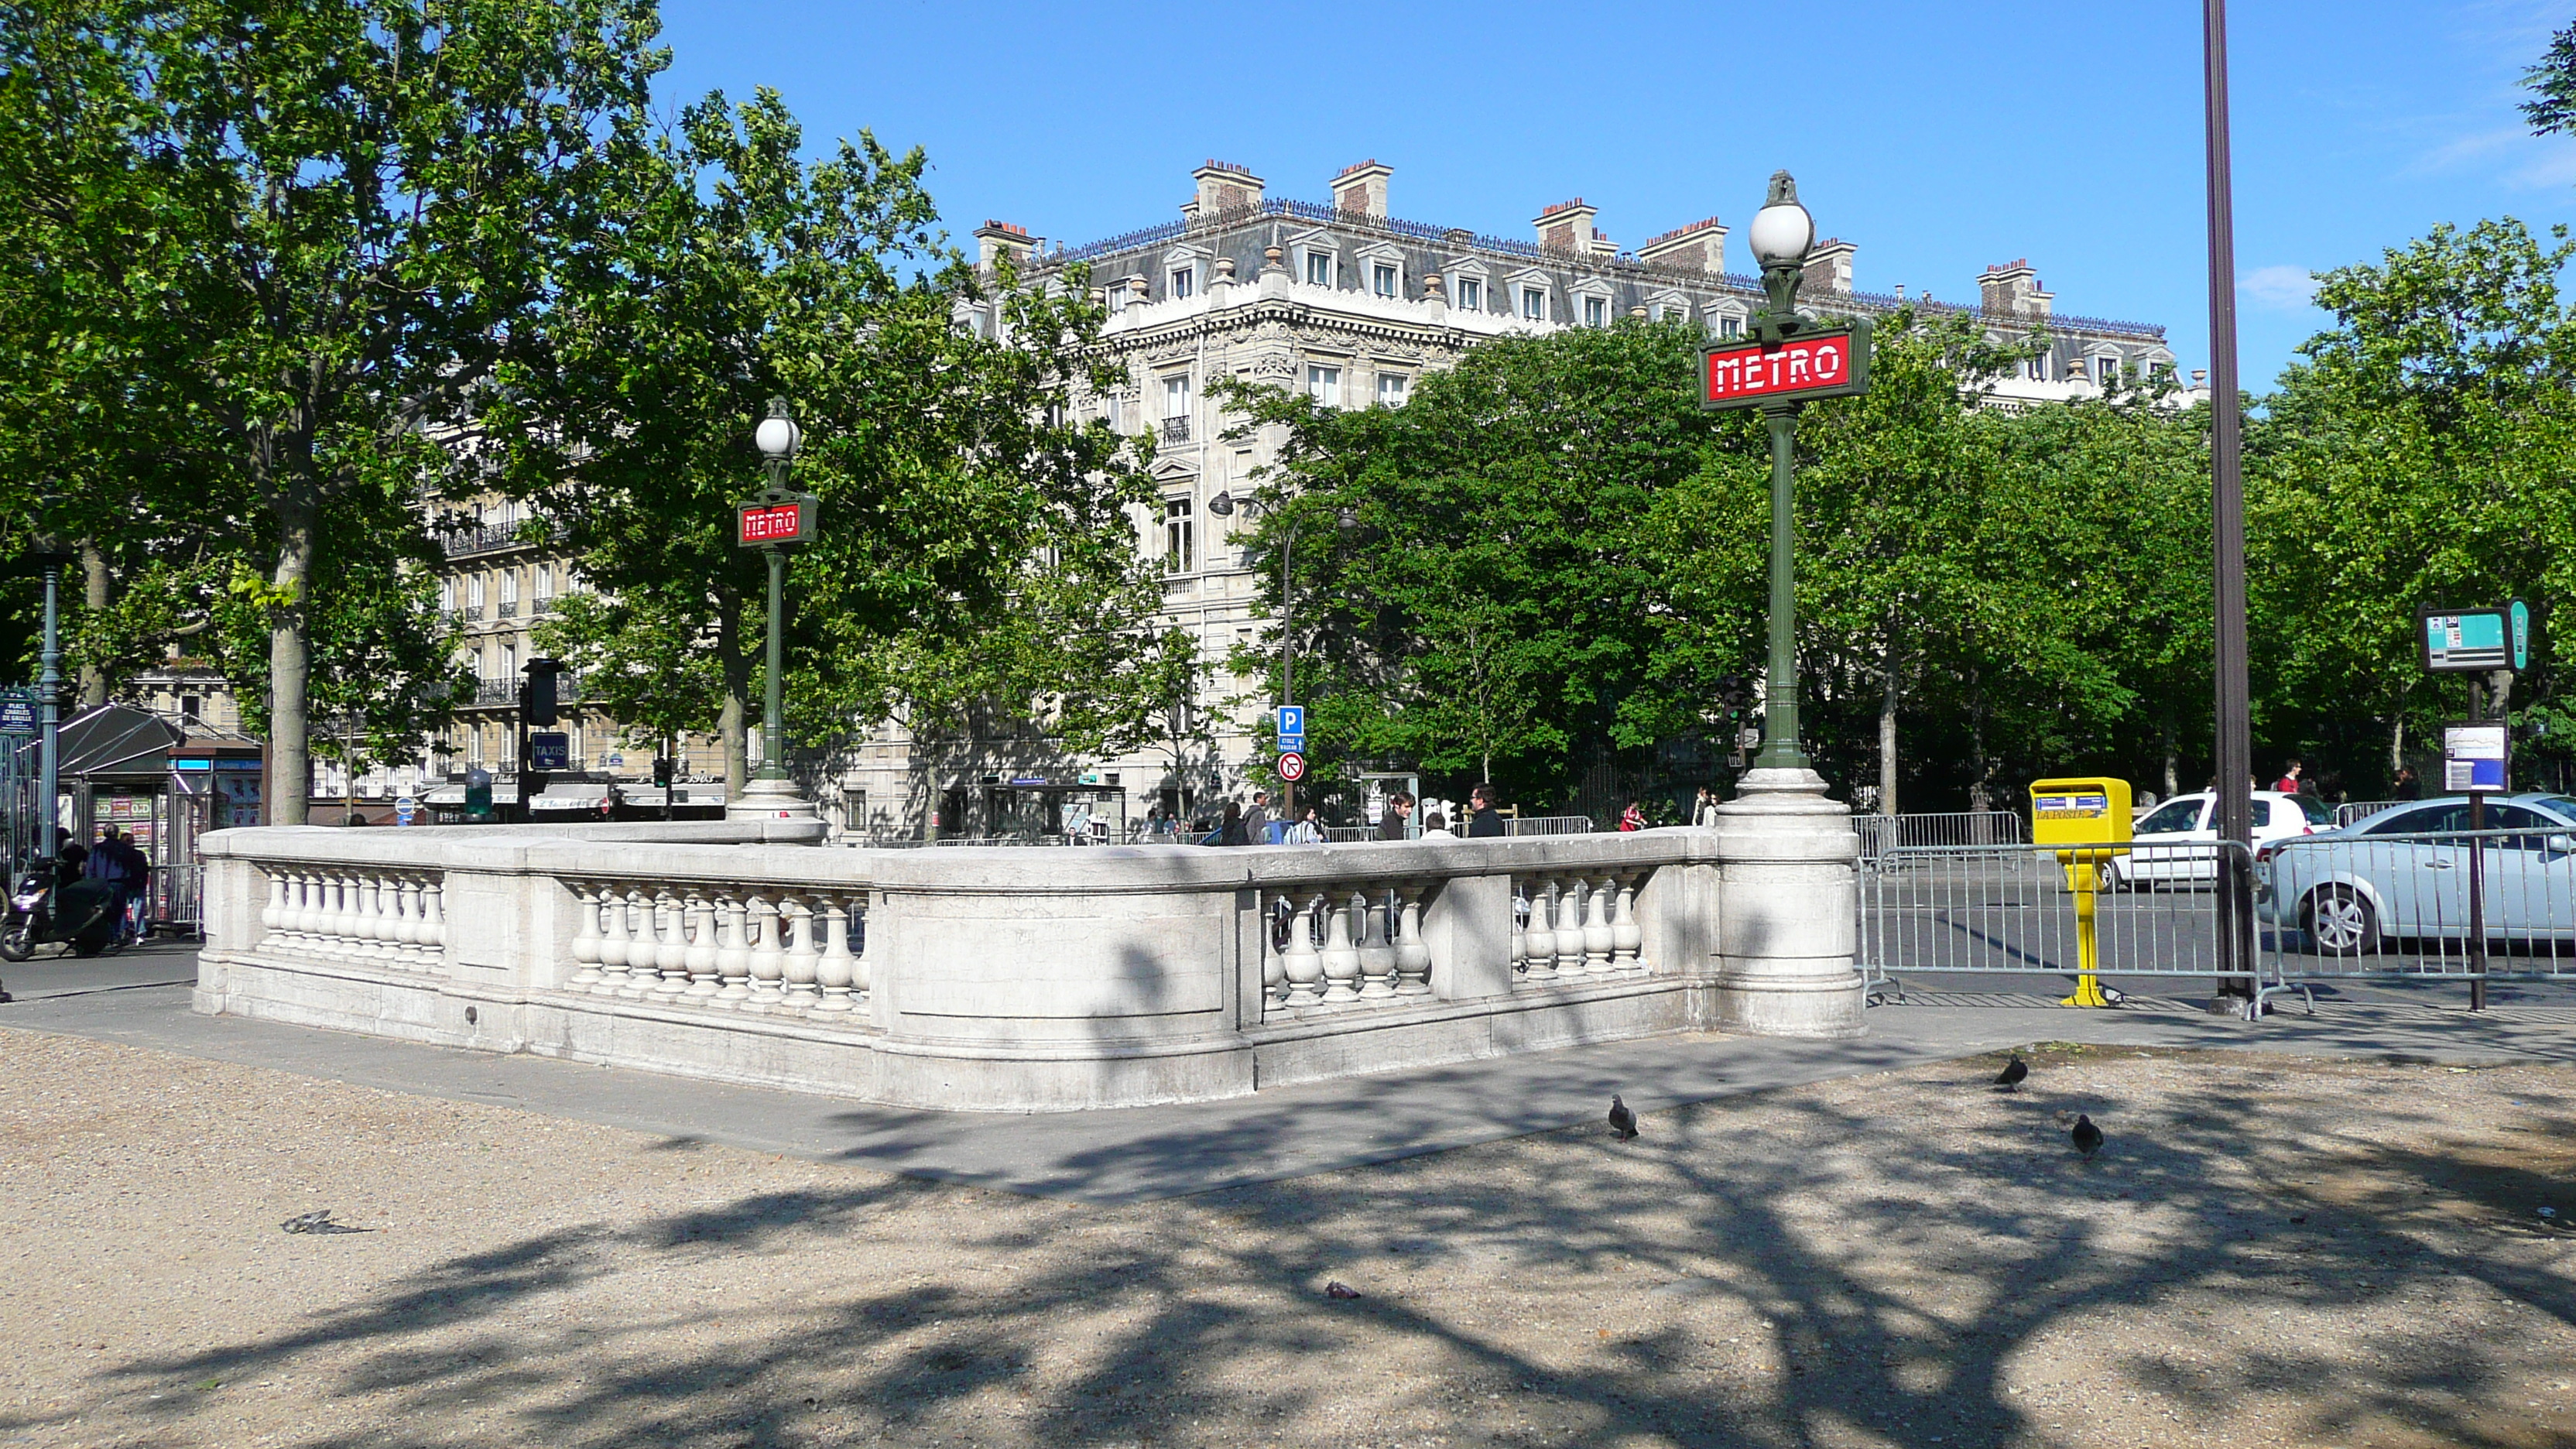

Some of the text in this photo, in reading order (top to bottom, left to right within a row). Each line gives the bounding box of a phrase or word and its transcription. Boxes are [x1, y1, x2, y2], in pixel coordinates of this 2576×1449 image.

[1717, 345, 1839, 393] METRO
[745, 511, 795, 537] METRO
[1285, 711, 1297, 730] P
[535, 745, 566, 756] TAXIS
[687, 774, 715, 784] 1903
[2036, 810, 2086, 820] LA POSTE
